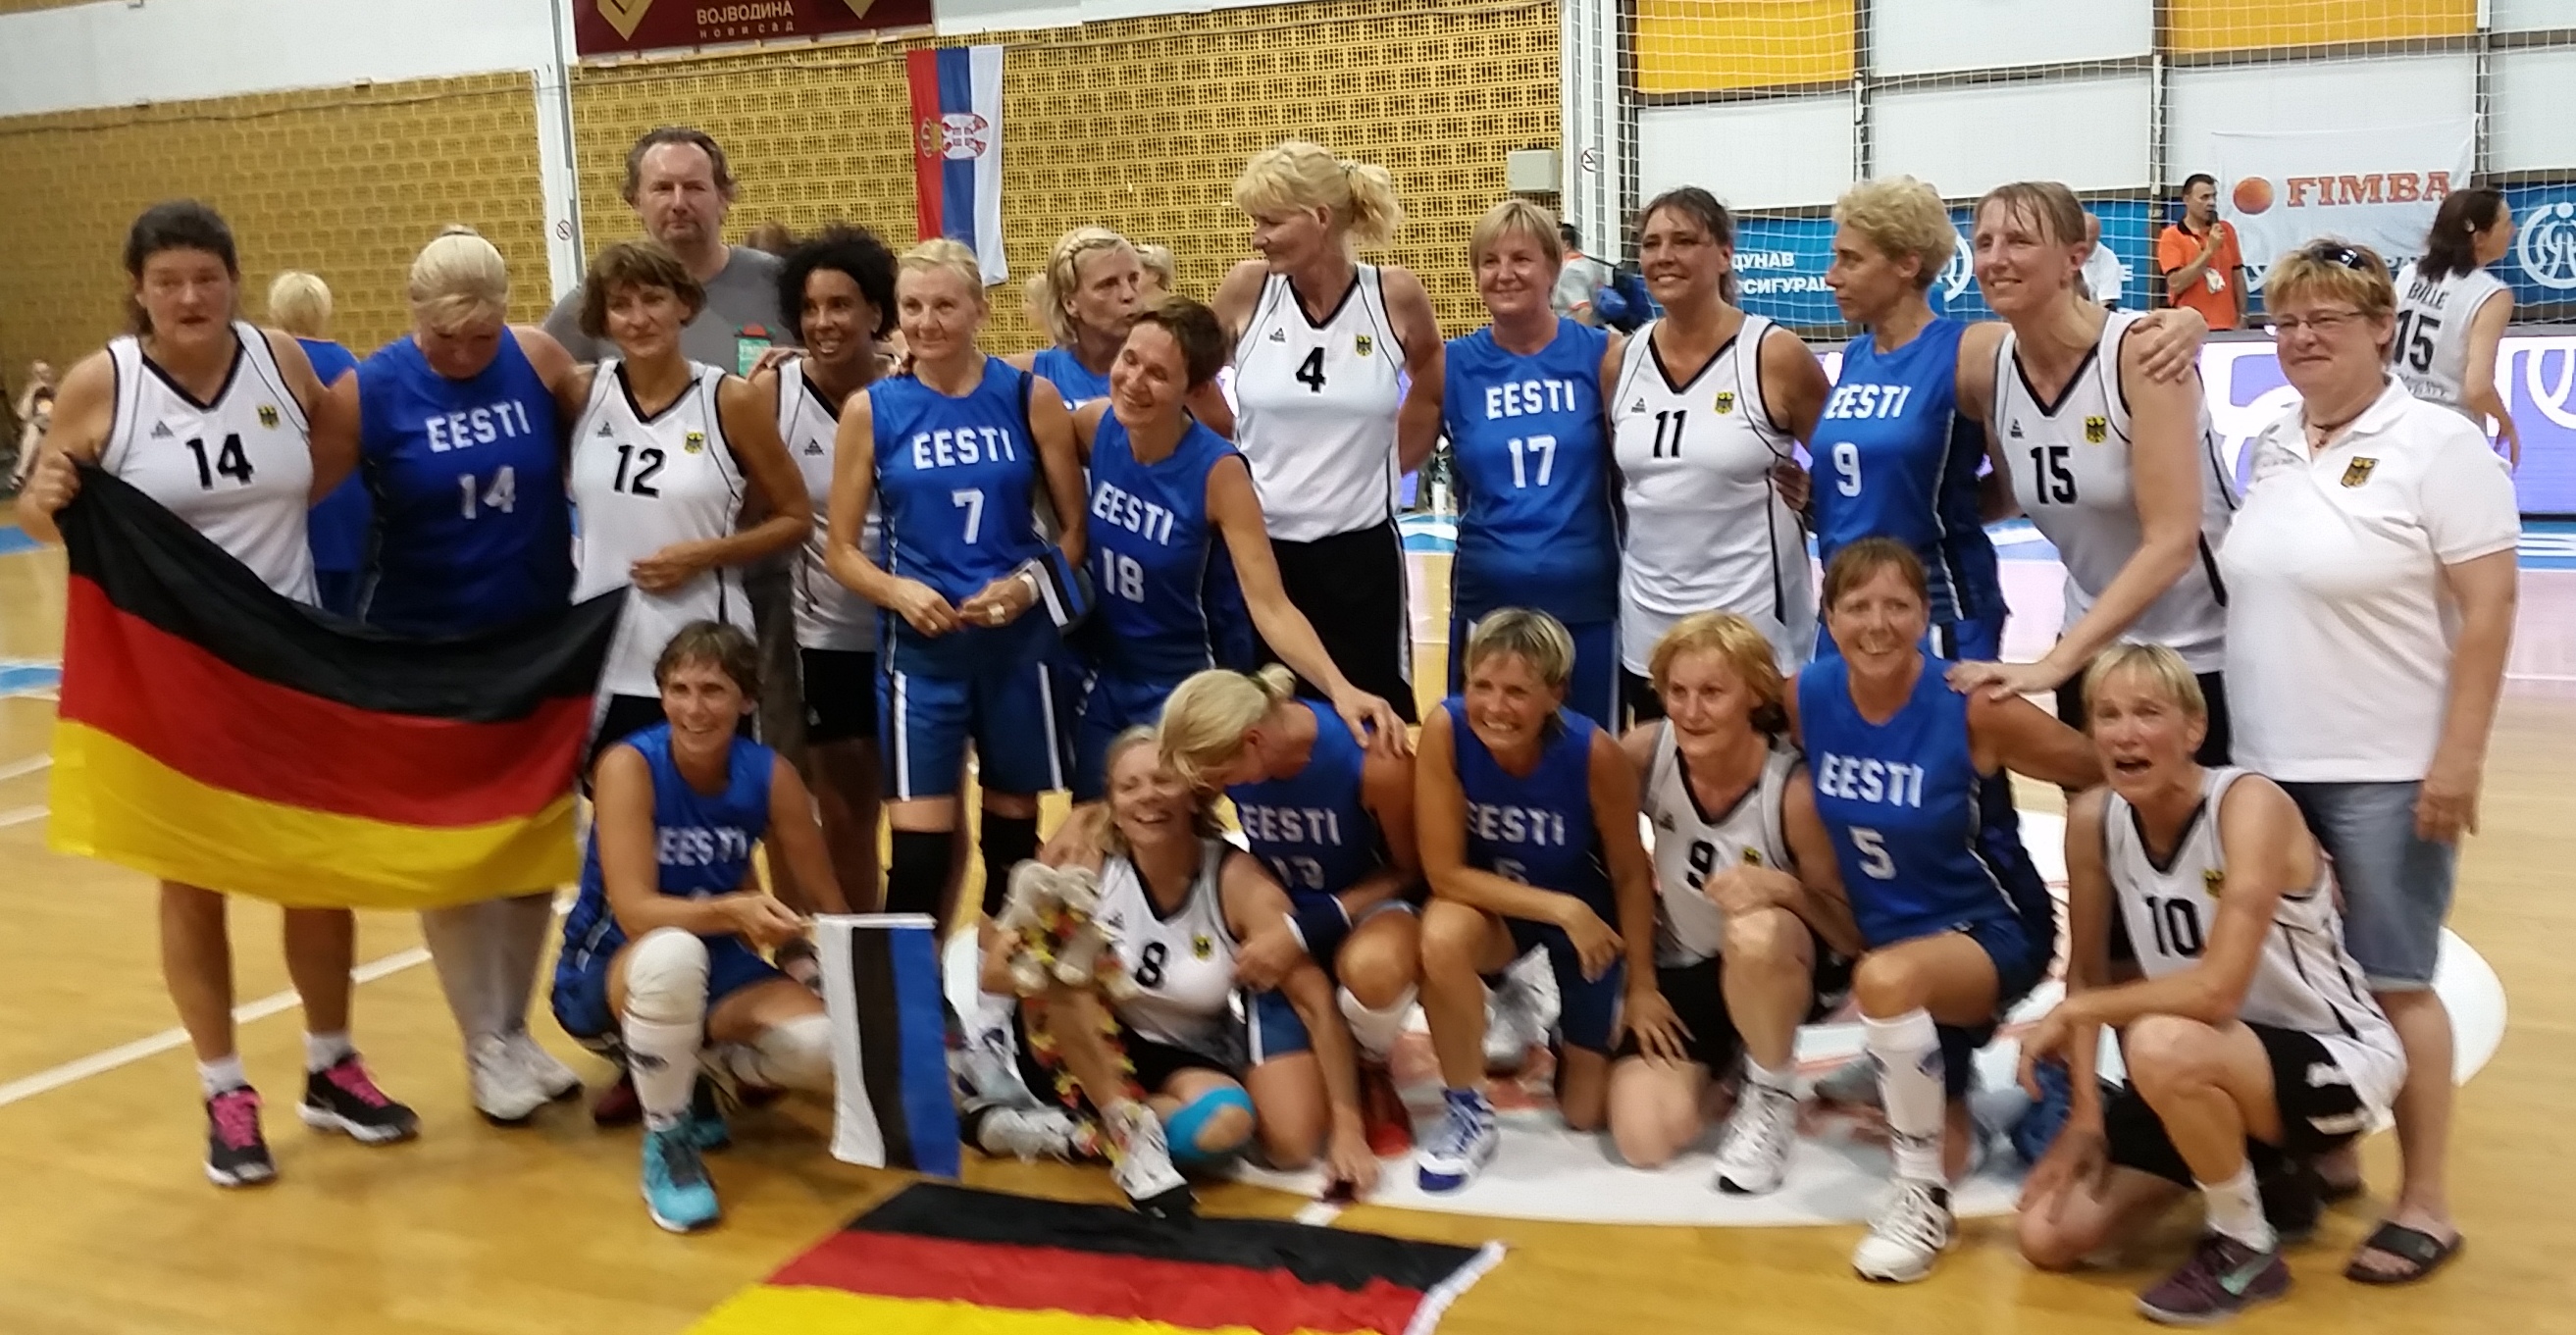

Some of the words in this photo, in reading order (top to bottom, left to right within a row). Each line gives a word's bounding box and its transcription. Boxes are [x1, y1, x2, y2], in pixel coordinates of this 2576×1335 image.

[696, 1, 794, 25] ВОЈВОДИНА
[2287, 171, 2453, 208] FIMBA
[1730, 251, 1794, 272] ДУНАВ
[2407, 282, 2449, 310] BILLE
[2394, 309, 2442, 373] 15
[1295, 346, 1326, 392] 4
[1486, 379, 1575, 419] EESTI
[1824, 384, 1912, 420] EESTI
[426, 400, 531, 454] EESTI
[912, 428, 1015, 470] EESTI
[1654, 409, 1687, 458] 11
[185, 433, 254, 490] 14
[613, 443, 667, 498] 12
[1508, 435, 1557, 488] 17
[1830, 441, 1862, 497] 9
[2031, 445, 2080, 504] 15
[458, 465, 516, 520] 14
[952, 488, 986, 544] 7
[1092, 481, 1174, 545] EESTI
[1102, 546, 1146, 603] 18
[1819, 752, 1923, 808] EESTI
[1240, 803, 1343, 847] EESTI
[1685, 840, 1718, 893] 9
[1850, 827, 1897, 880] 5
[2146, 897, 2205, 957] 10
[1135, 942, 1168, 989] 8
